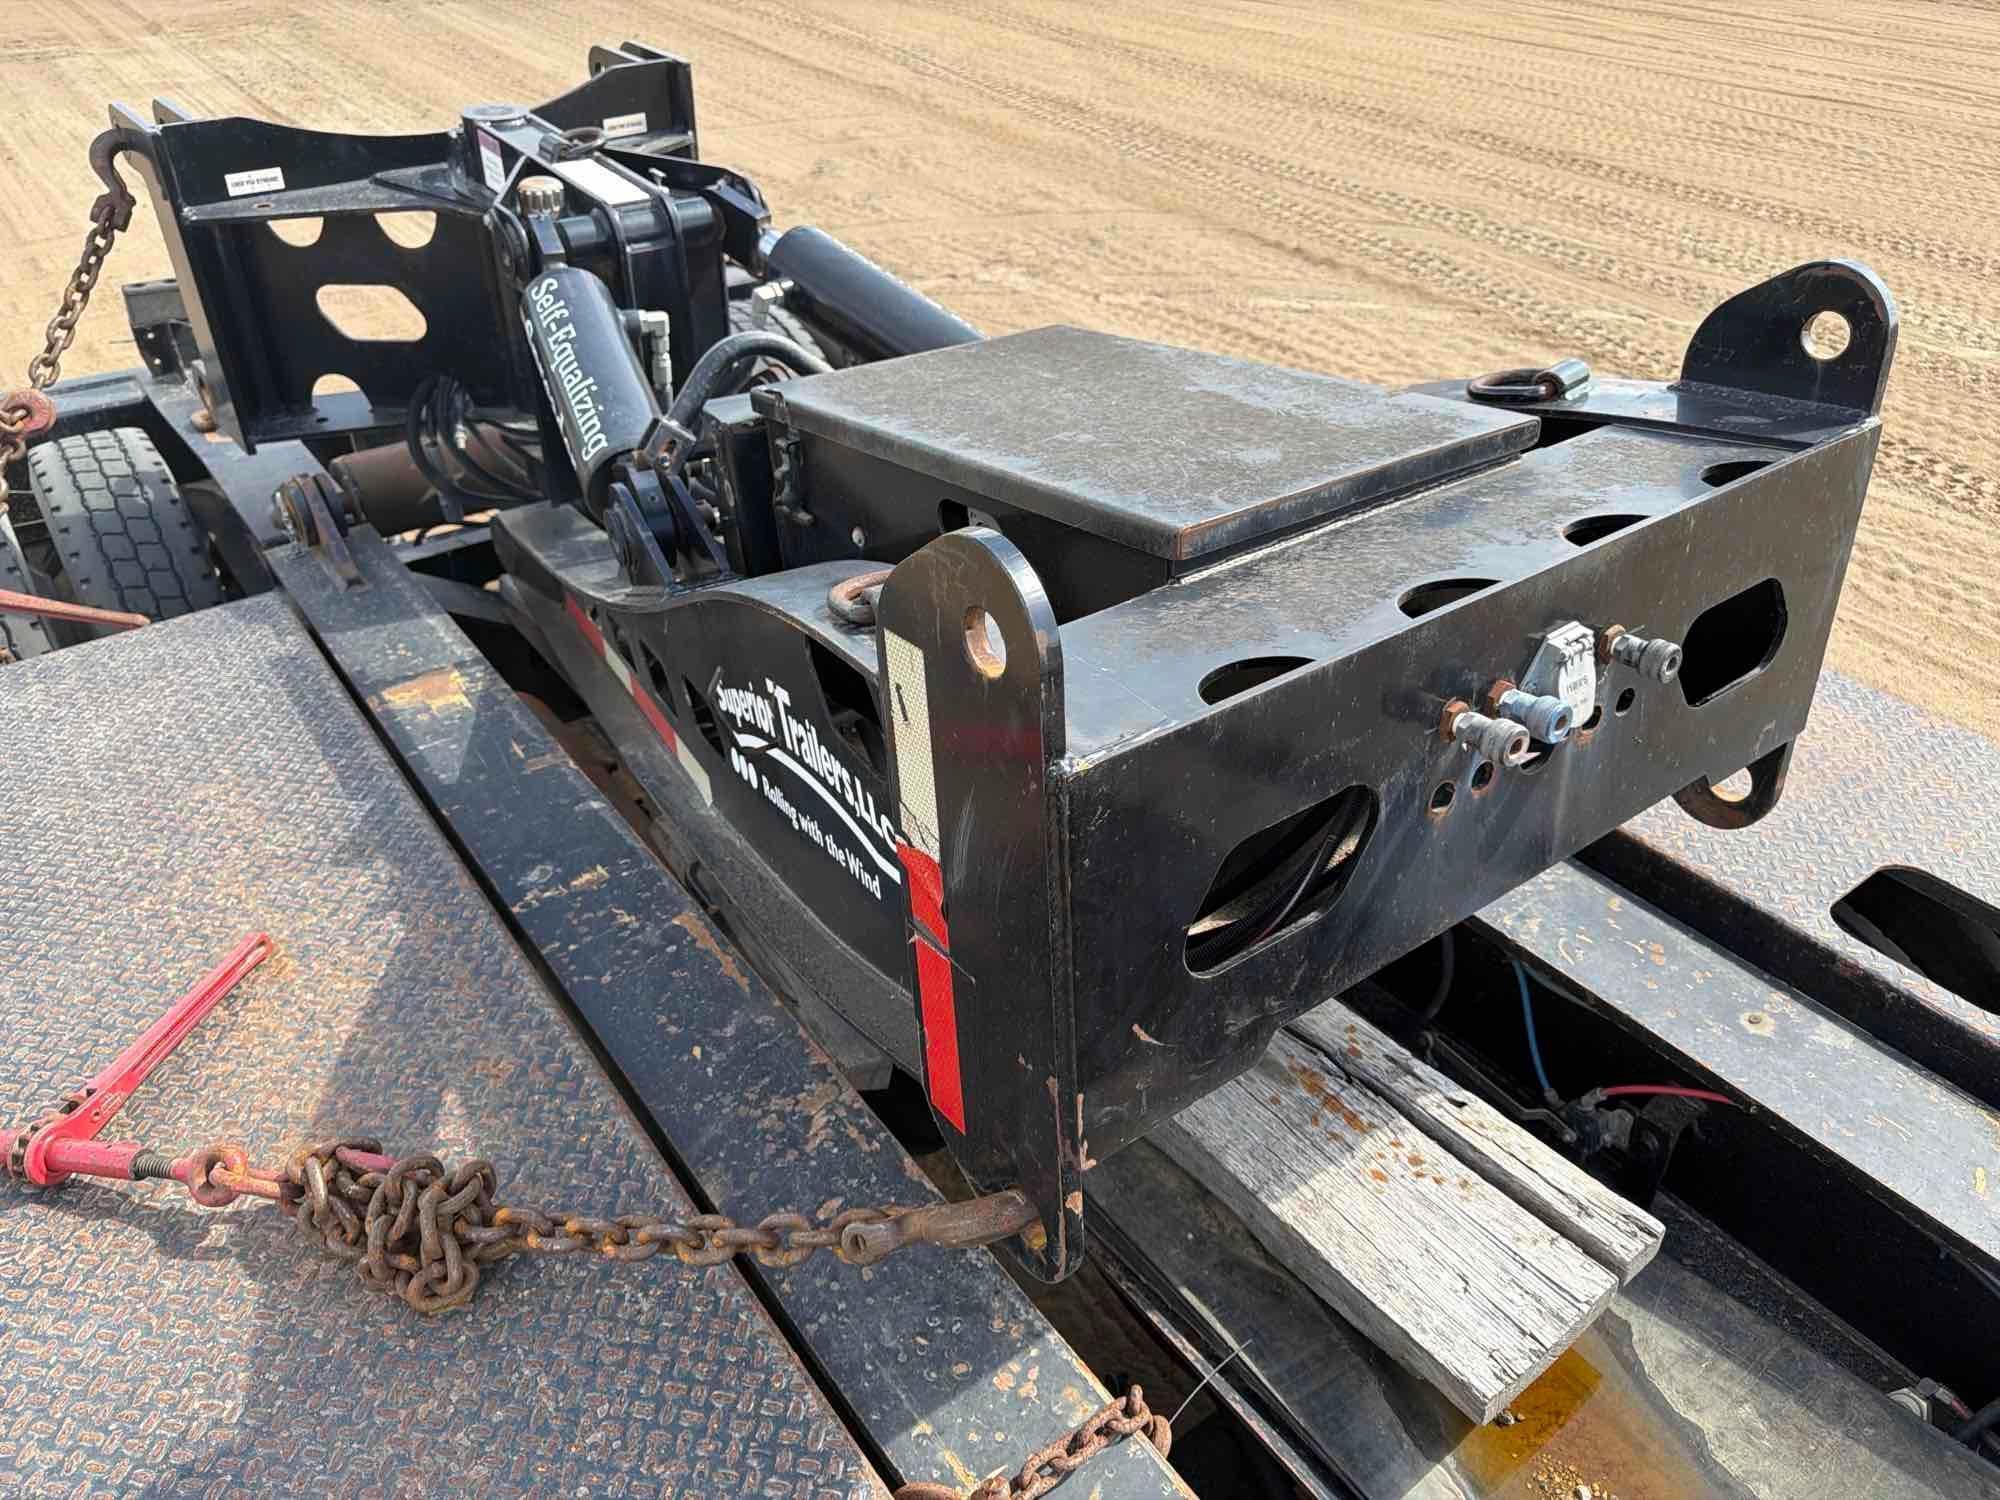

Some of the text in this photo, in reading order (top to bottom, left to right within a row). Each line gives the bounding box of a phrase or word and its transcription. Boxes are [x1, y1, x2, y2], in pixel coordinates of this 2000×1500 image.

[531, 277, 609, 461] Self-Equalizing
[715, 679, 776, 739] Superior
[761, 774, 882, 900] Rolling with the Wind
